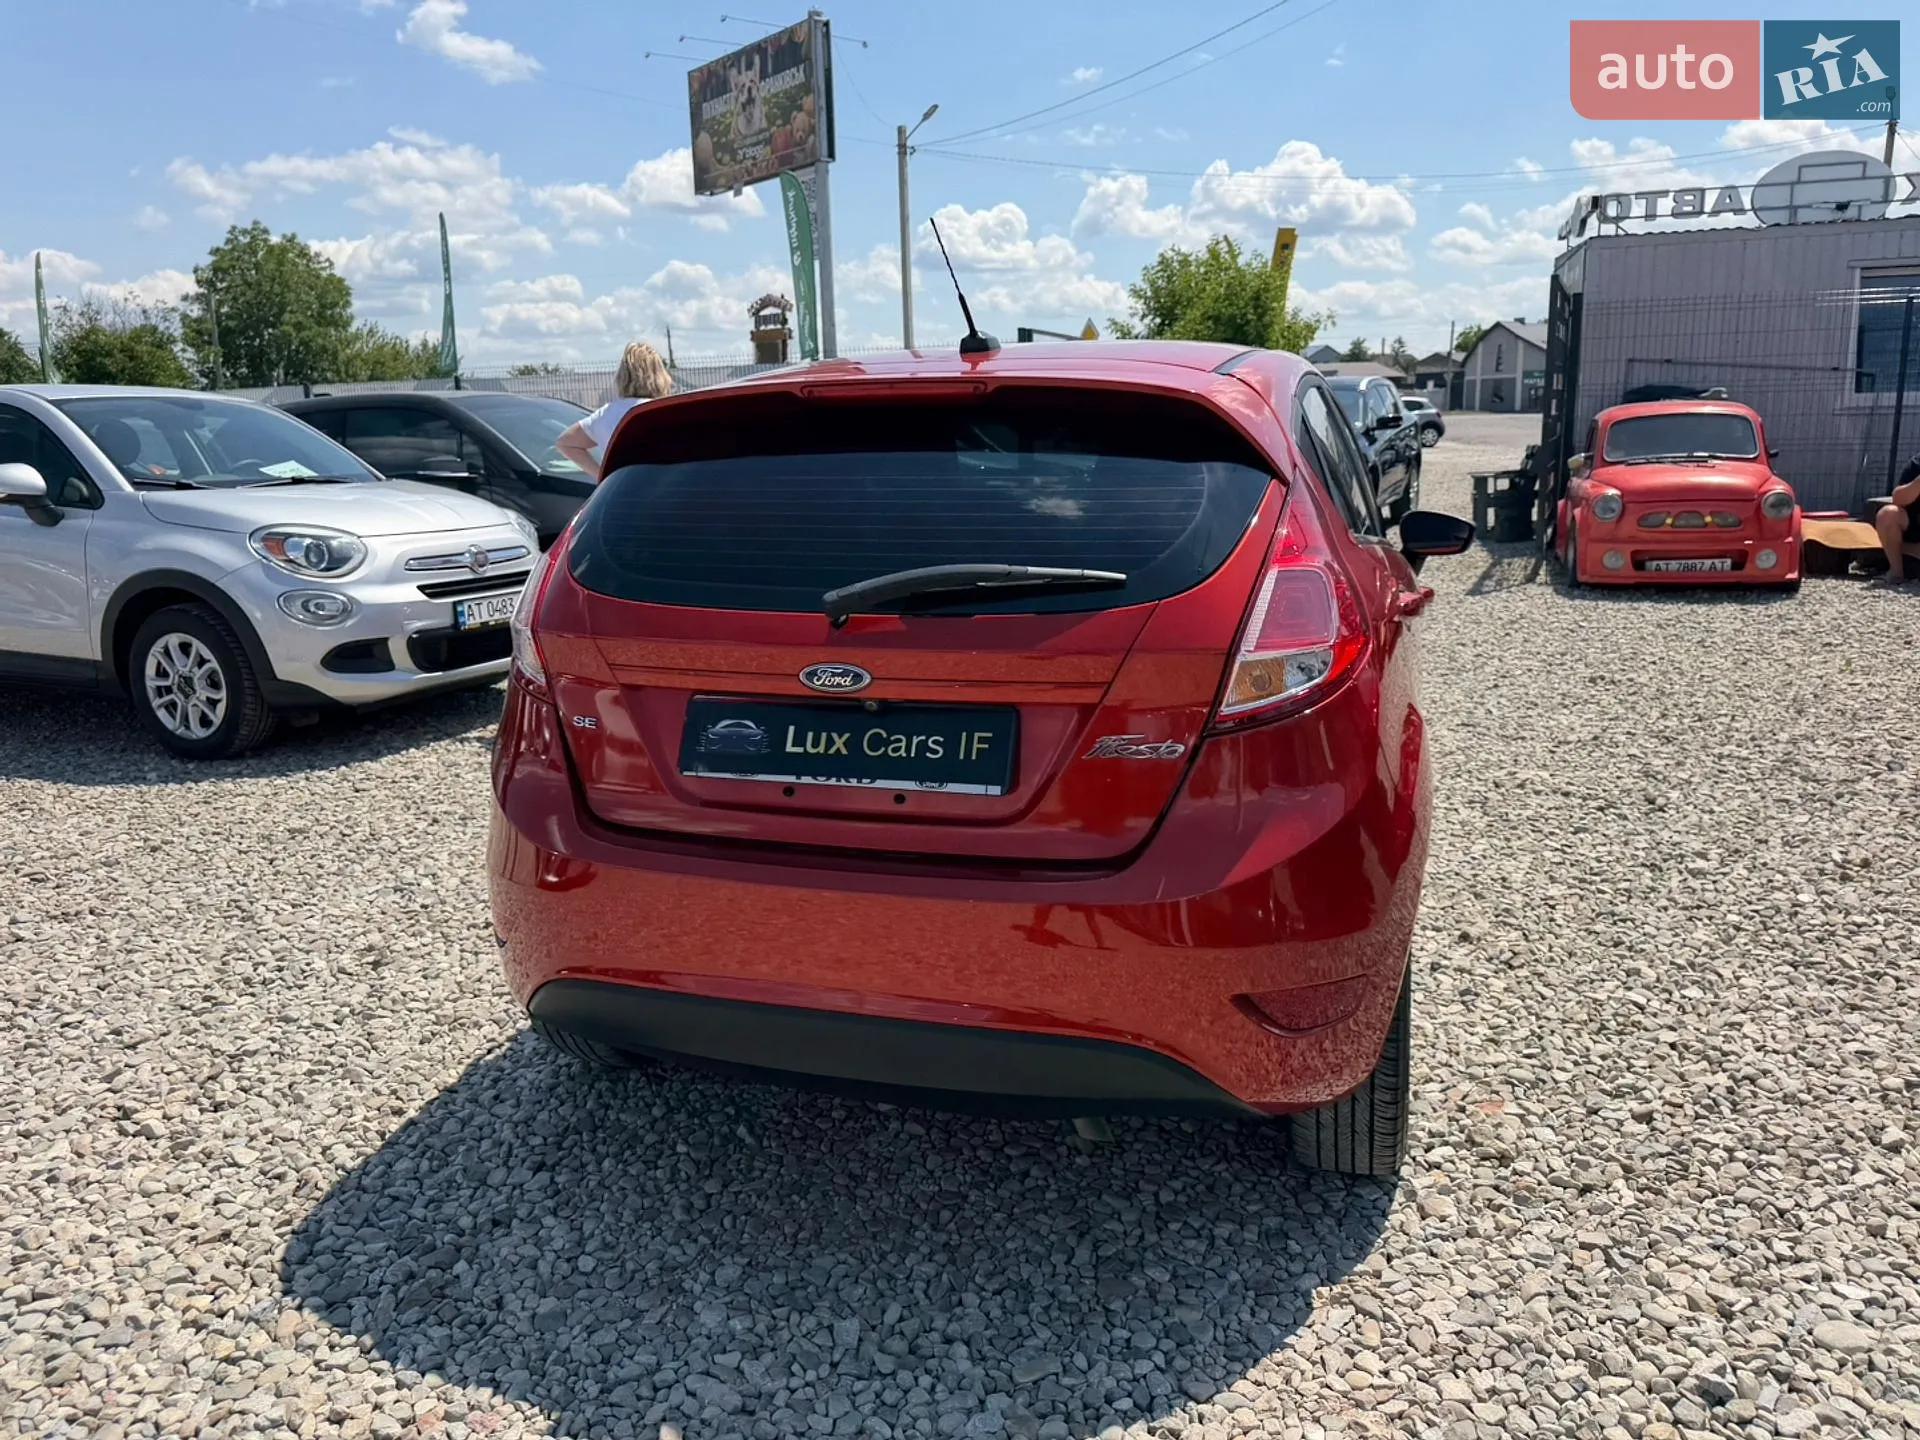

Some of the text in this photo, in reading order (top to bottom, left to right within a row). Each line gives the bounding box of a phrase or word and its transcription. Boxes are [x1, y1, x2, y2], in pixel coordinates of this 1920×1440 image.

[1654, 562, 1672, 572] AT
[1708, 560, 1728, 572] AT
[467, 597, 515, 621] AT 0483
[813, 668, 853, 686] Ford
[572, 715, 597, 729] SE
[785, 725, 993, 761] Lux Cars IF
[1081, 734, 1185, 760] Fiesta
